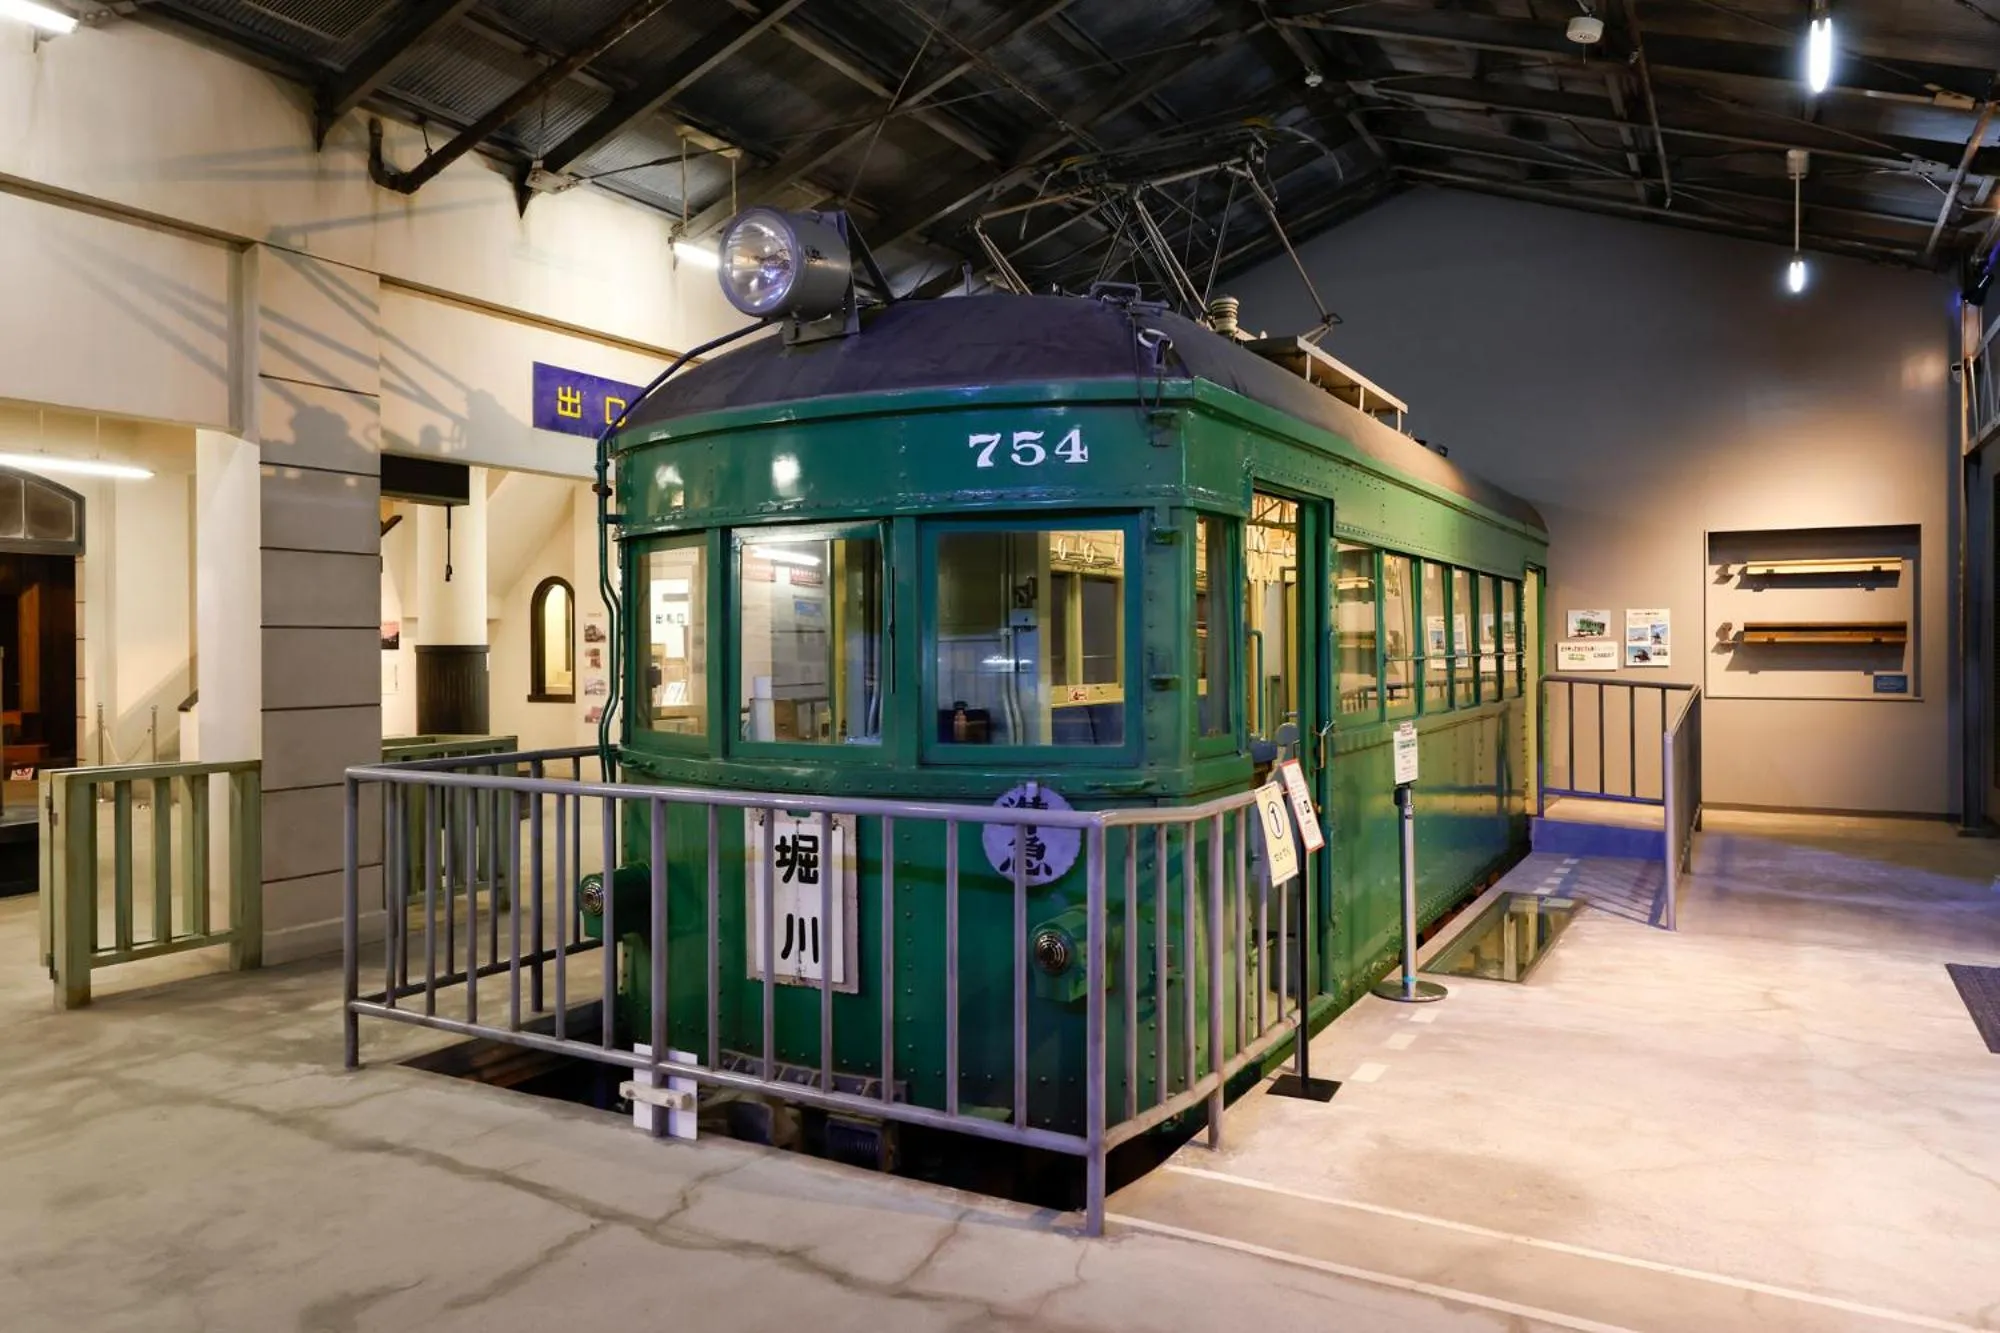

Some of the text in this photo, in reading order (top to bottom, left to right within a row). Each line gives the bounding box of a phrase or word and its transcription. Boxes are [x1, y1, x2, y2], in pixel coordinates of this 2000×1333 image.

[557, 386, 627, 427] 出口
[968, 428, 1089, 468] 754
[774, 833, 820, 964] 堀川
